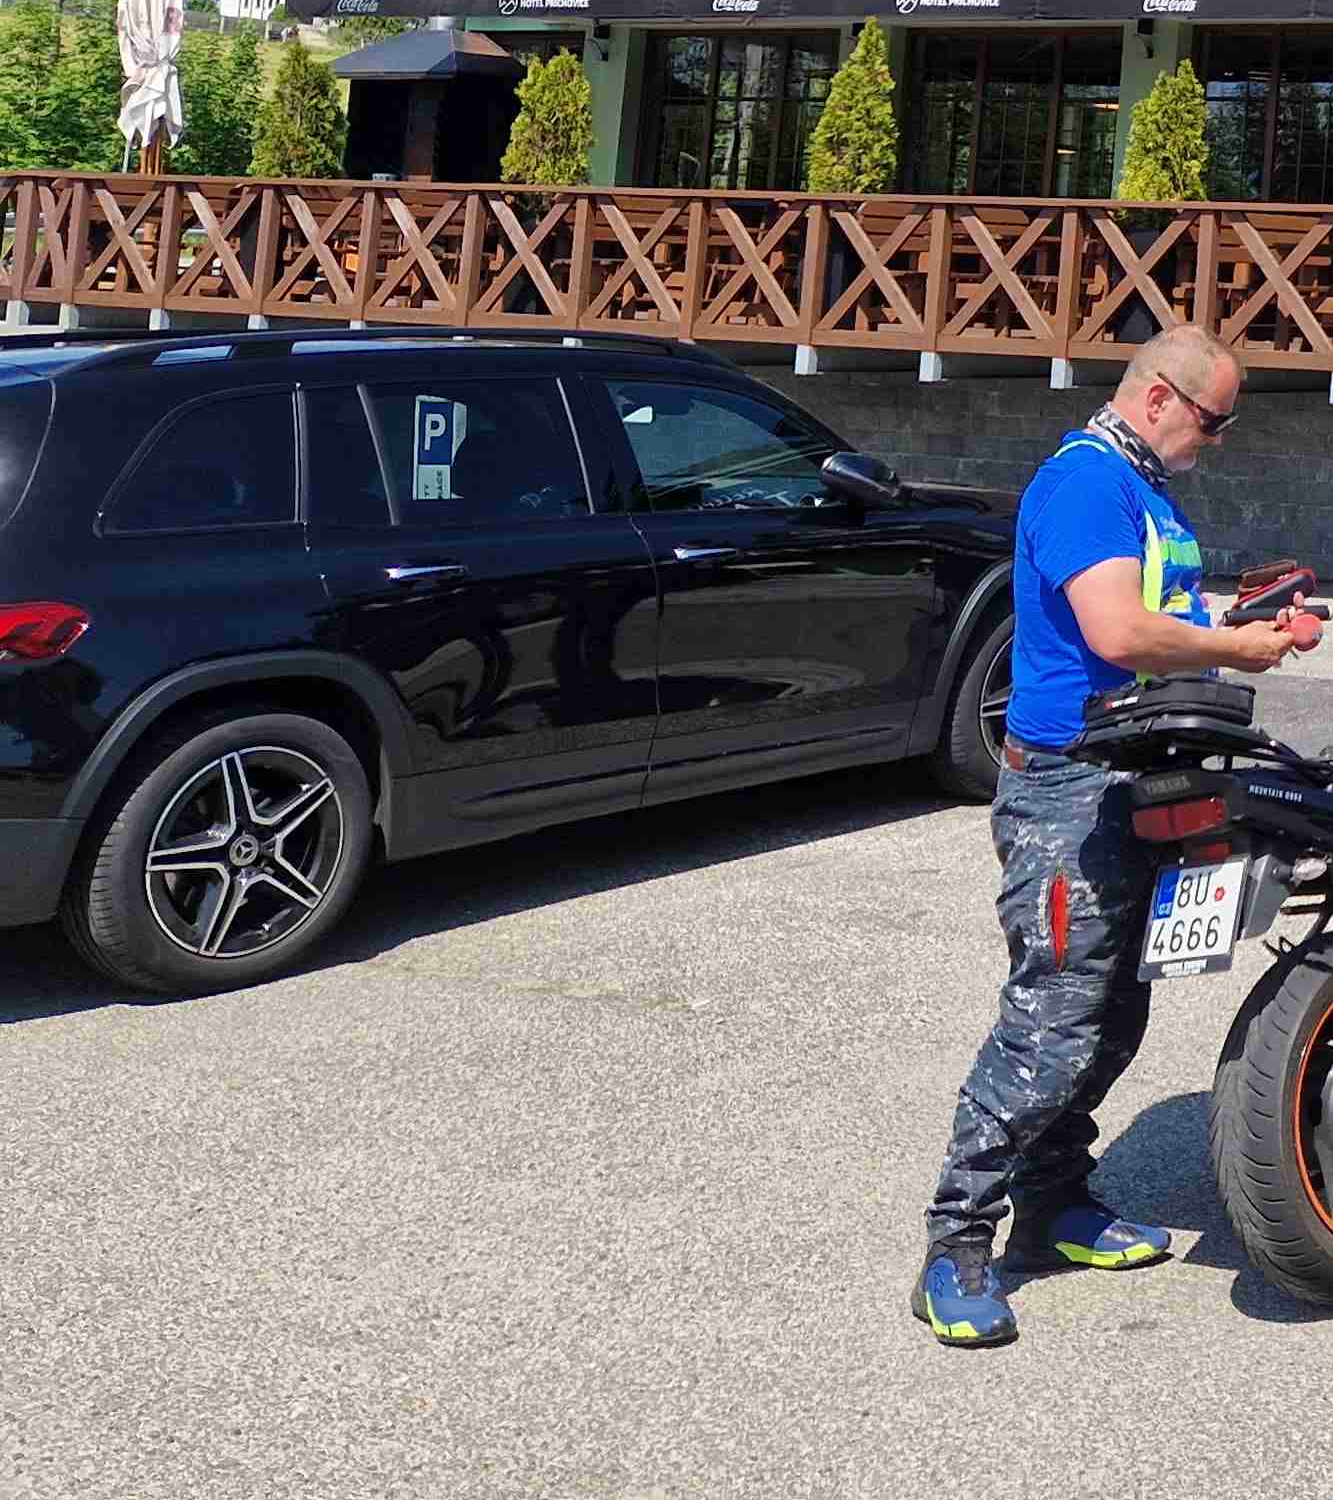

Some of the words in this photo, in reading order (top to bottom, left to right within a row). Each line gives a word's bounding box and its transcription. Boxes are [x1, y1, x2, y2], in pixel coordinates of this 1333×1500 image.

[425, 412, 446, 451] P
[1177, 870, 1213, 908] 8U
[1152, 915, 1221, 955] 4666
